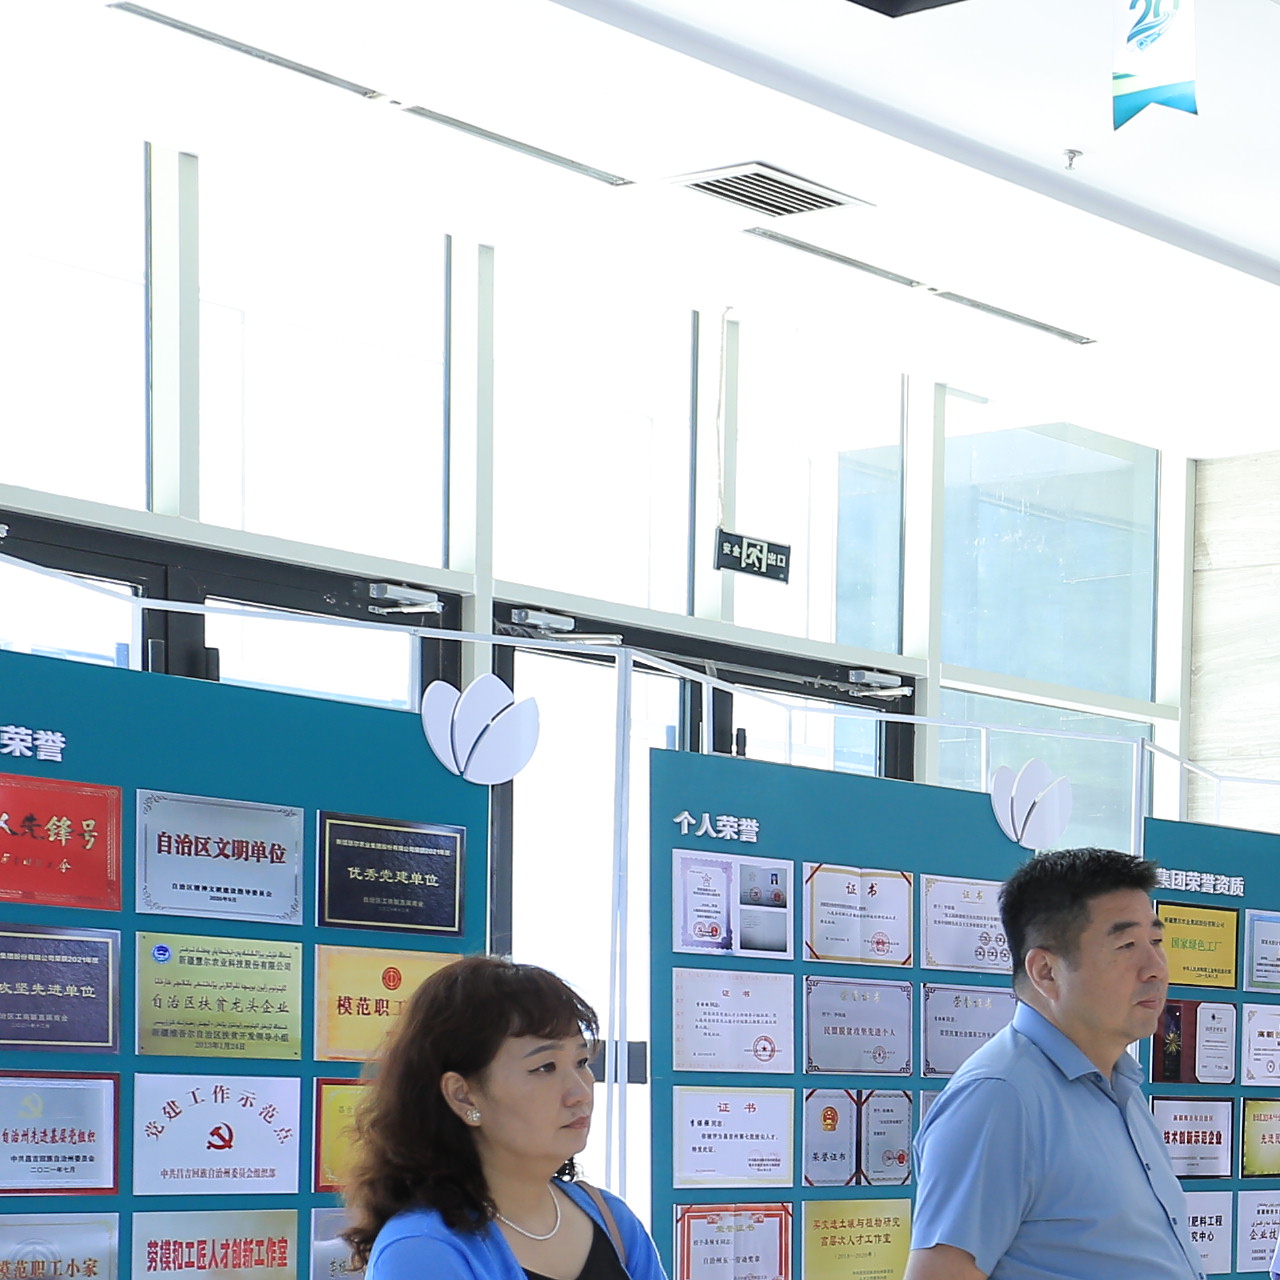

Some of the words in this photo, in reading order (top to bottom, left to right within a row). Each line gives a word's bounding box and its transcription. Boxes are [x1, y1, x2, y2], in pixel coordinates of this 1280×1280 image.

[722, 541, 741, 557] 安全
[767, 552, 786, 567] 出口
[0, 725, 67, 762] 荣誉
[672, 810, 760, 843] 个人荣誉
[157, 831, 287, 864] 自治区文明单位
[347, 866, 440, 887] 优秀党建单位
[1155, 867, 1245, 898] 集团荣誉资质
[846, 881, 878, 897] 证书
[1171, 937, 1223, 952] 国家绿色工厂
[152, 993, 290, 1014] 自治区扶贫龙头企业
[144, 1084, 293, 1145] 党建工作示范点
[717, 1101, 757, 1114] 证书
[1163, 1130, 1222, 1146] 技术创新示范企业
[812, 1151, 847, 1163] 荣誉证书
[1187, 1215, 1223, 1227] 肥料工程
[147, 1236, 288, 1272] 劳模和工匠人才创新工作室
